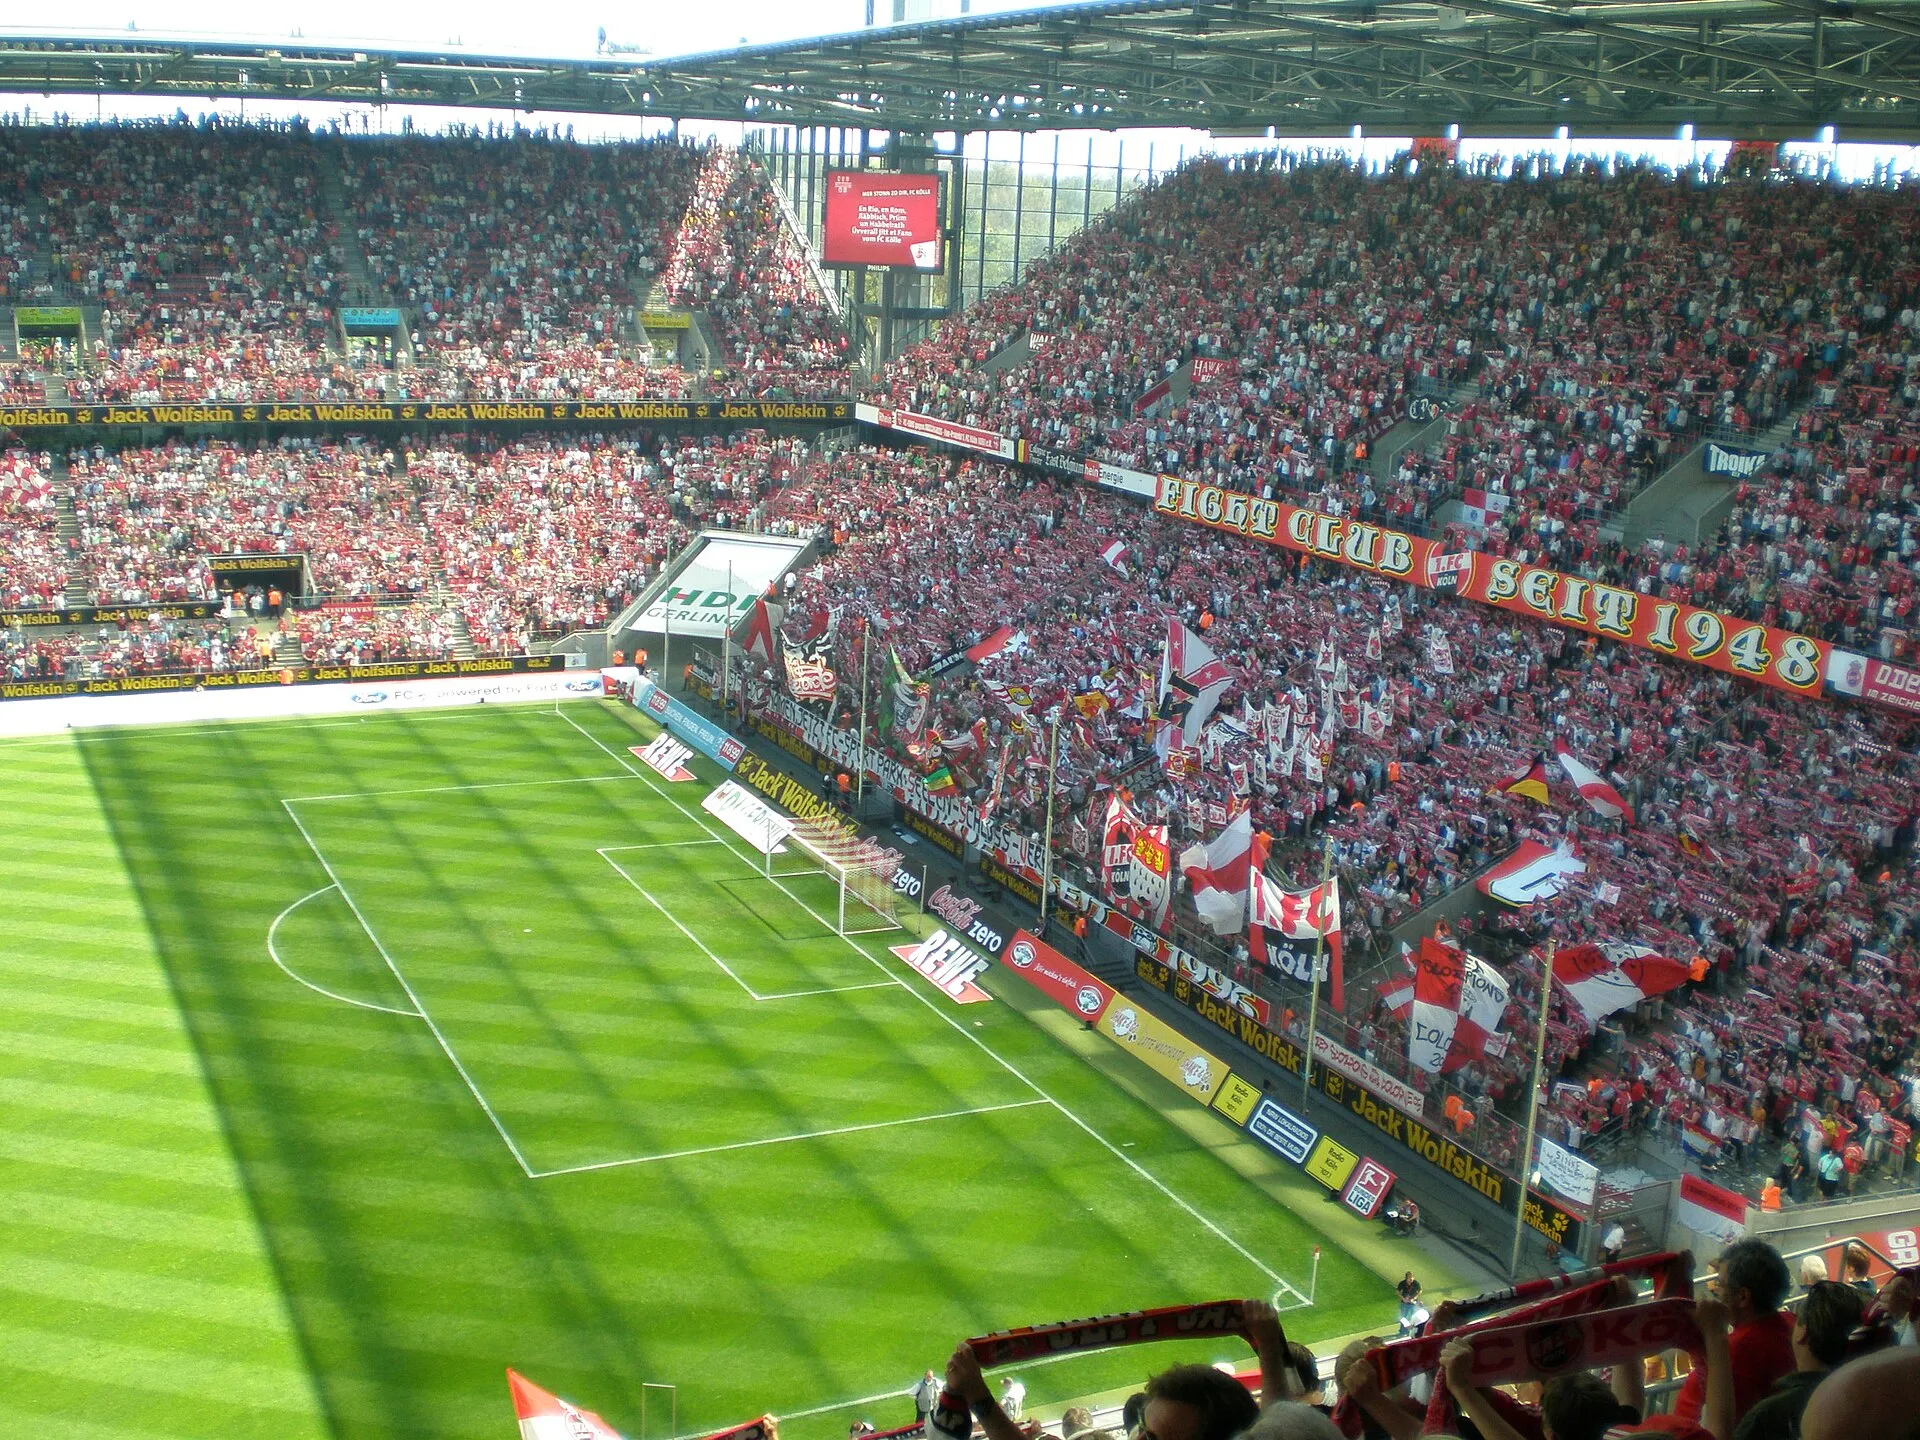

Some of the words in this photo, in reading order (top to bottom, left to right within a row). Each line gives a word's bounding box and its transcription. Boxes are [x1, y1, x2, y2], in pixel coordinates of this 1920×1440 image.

[868, 205, 881, 213] Rio,
[867, 264, 891, 272] PHILIPS
[102, 406, 149, 424] Jack
[151, 405, 234, 423] Wolfskin
[266, 404, 312, 421] Jack
[313, 404, 393, 420] Wolfskin
[425, 403, 467, 420] Jack
[470, 403, 545, 420] Wolfskin
[574, 403, 616, 419] Jack
[618, 403, 688, 418] Wolfskin
[719, 403, 759, 418] Jack
[760, 403, 827, 418] Wolfskin
[1084, 463, 1124, 485] heinEnergie
[1156, 475, 1278, 537] FIGHT
[1289, 510, 1414, 575] CLUB
[211, 559, 237, 571] Jack
[240, 558, 288, 570] Wolfskin
[1435, 554, 1463, 571] 1.FC
[1437, 573, 1458, 586] KÖLN
[660, 587, 760, 611] HDI
[2, 613, 61, 627] Wolfskin
[129, 608, 185, 622] Wolskin
[646, 606, 742, 626] GERLING
[1486, 559, 1637, 637] SEIT
[1648, 603, 1822, 690] 1948
[314, 668, 347, 680] Jack
[350, 664, 406, 679] Wolfskin
[424, 662, 456, 674] Jack
[459, 659, 513, 672] Wolfskin
[3, 684, 62, 698] Wolfskin
[84, 680, 118, 693] Jack
[121, 677, 179, 691] Wolfskin
[202, 674, 233, 687] Jack
[235, 671, 281, 685] Wolfsk
[567, 680, 599, 691] Ford
[641, 732, 694, 778] REWE
[721, 741, 741, 760] 11899
[748, 760, 784, 799] Jack
[891, 867, 922, 897] zero
[1111, 868, 1130, 883] KÖLN
[967, 919, 1003, 953] zero
[908, 930, 990, 996] REWE
[1265, 942, 1331, 984] KÖLN
[1196, 990, 1240, 1035] Jack
[1230, 1093, 1243, 1106] Köln
[1233, 1083, 1249, 1098] Radio
[1266, 1127, 1276, 1137] DIE
[1273, 1132, 1288, 1145] BESTE
[1327, 1147, 1345, 1163] Radio
[1351, 1090, 1402, 1140] Jack
[1405, 1119, 1503, 1204] Wolfskin
[1325, 1157, 1338, 1171] Köln
[1347, 1190, 1371, 1214] LIGA
[1525, 1201, 1544, 1220] ack
